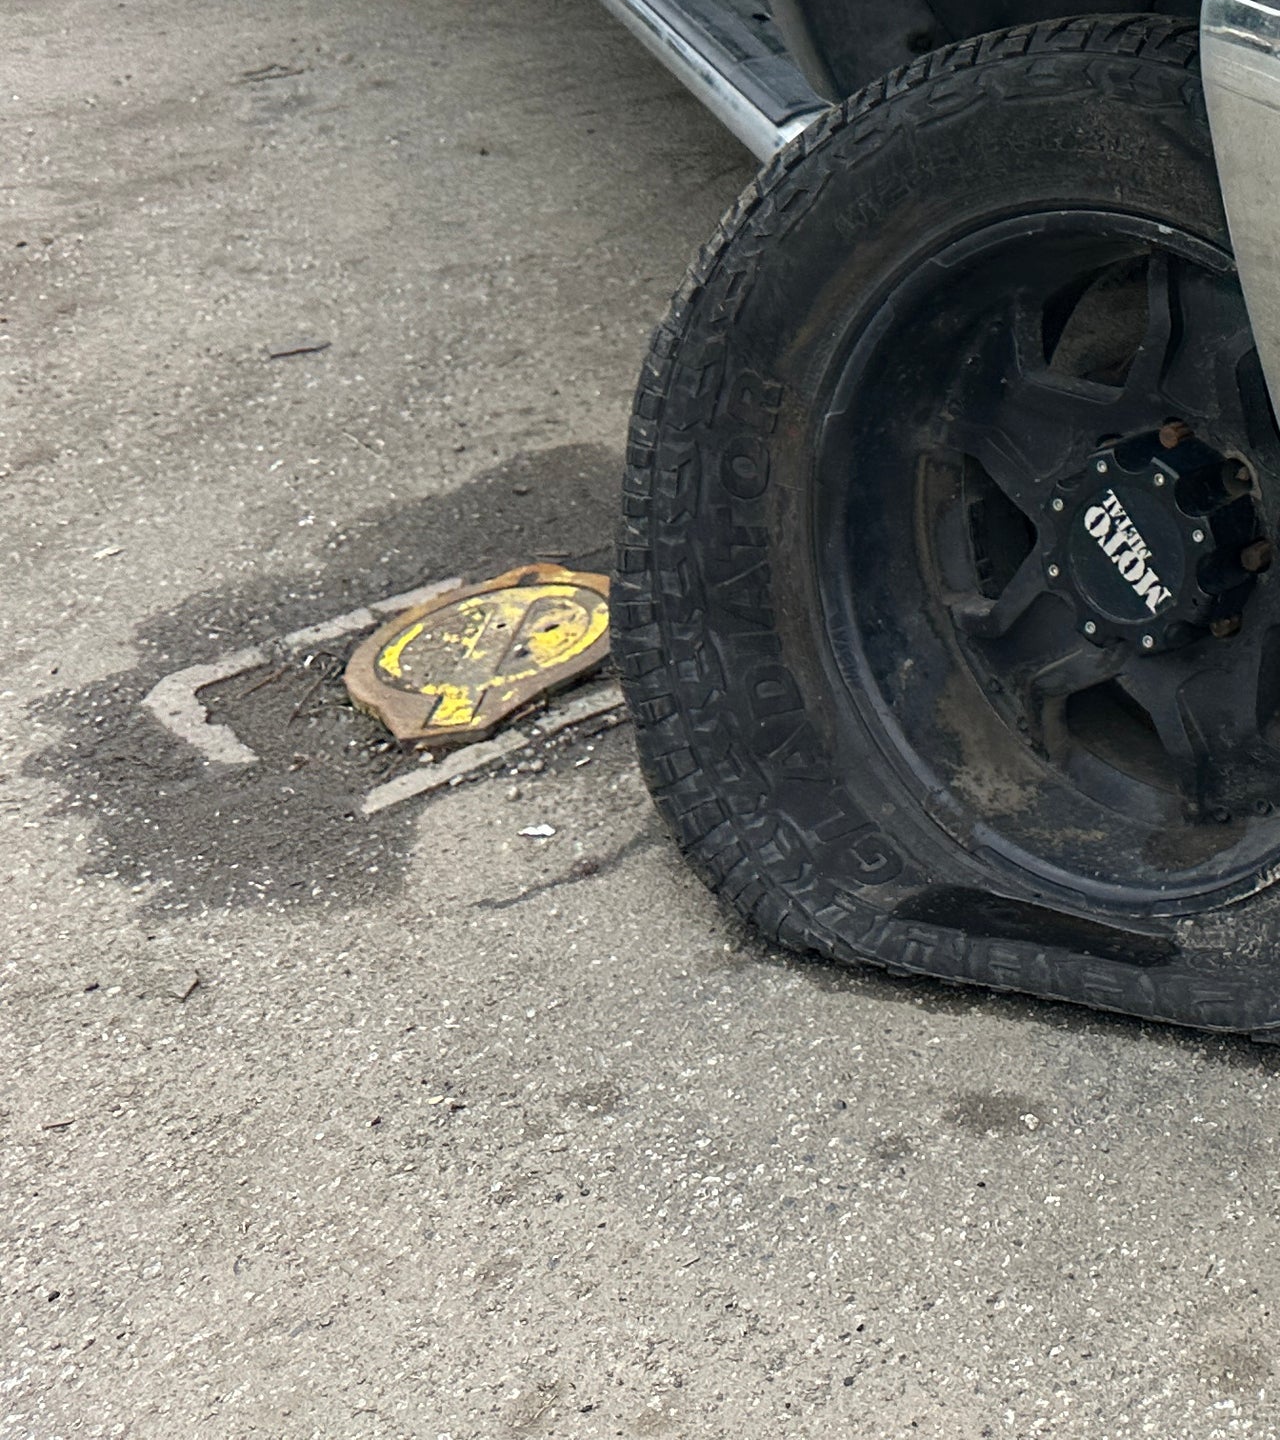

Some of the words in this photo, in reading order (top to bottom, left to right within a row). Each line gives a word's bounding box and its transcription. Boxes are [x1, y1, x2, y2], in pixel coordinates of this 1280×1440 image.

[1084, 506, 1172, 614] MOTO
[1103, 488, 1153, 560] METAL
[716, 369, 906, 885] GLADIATOR
